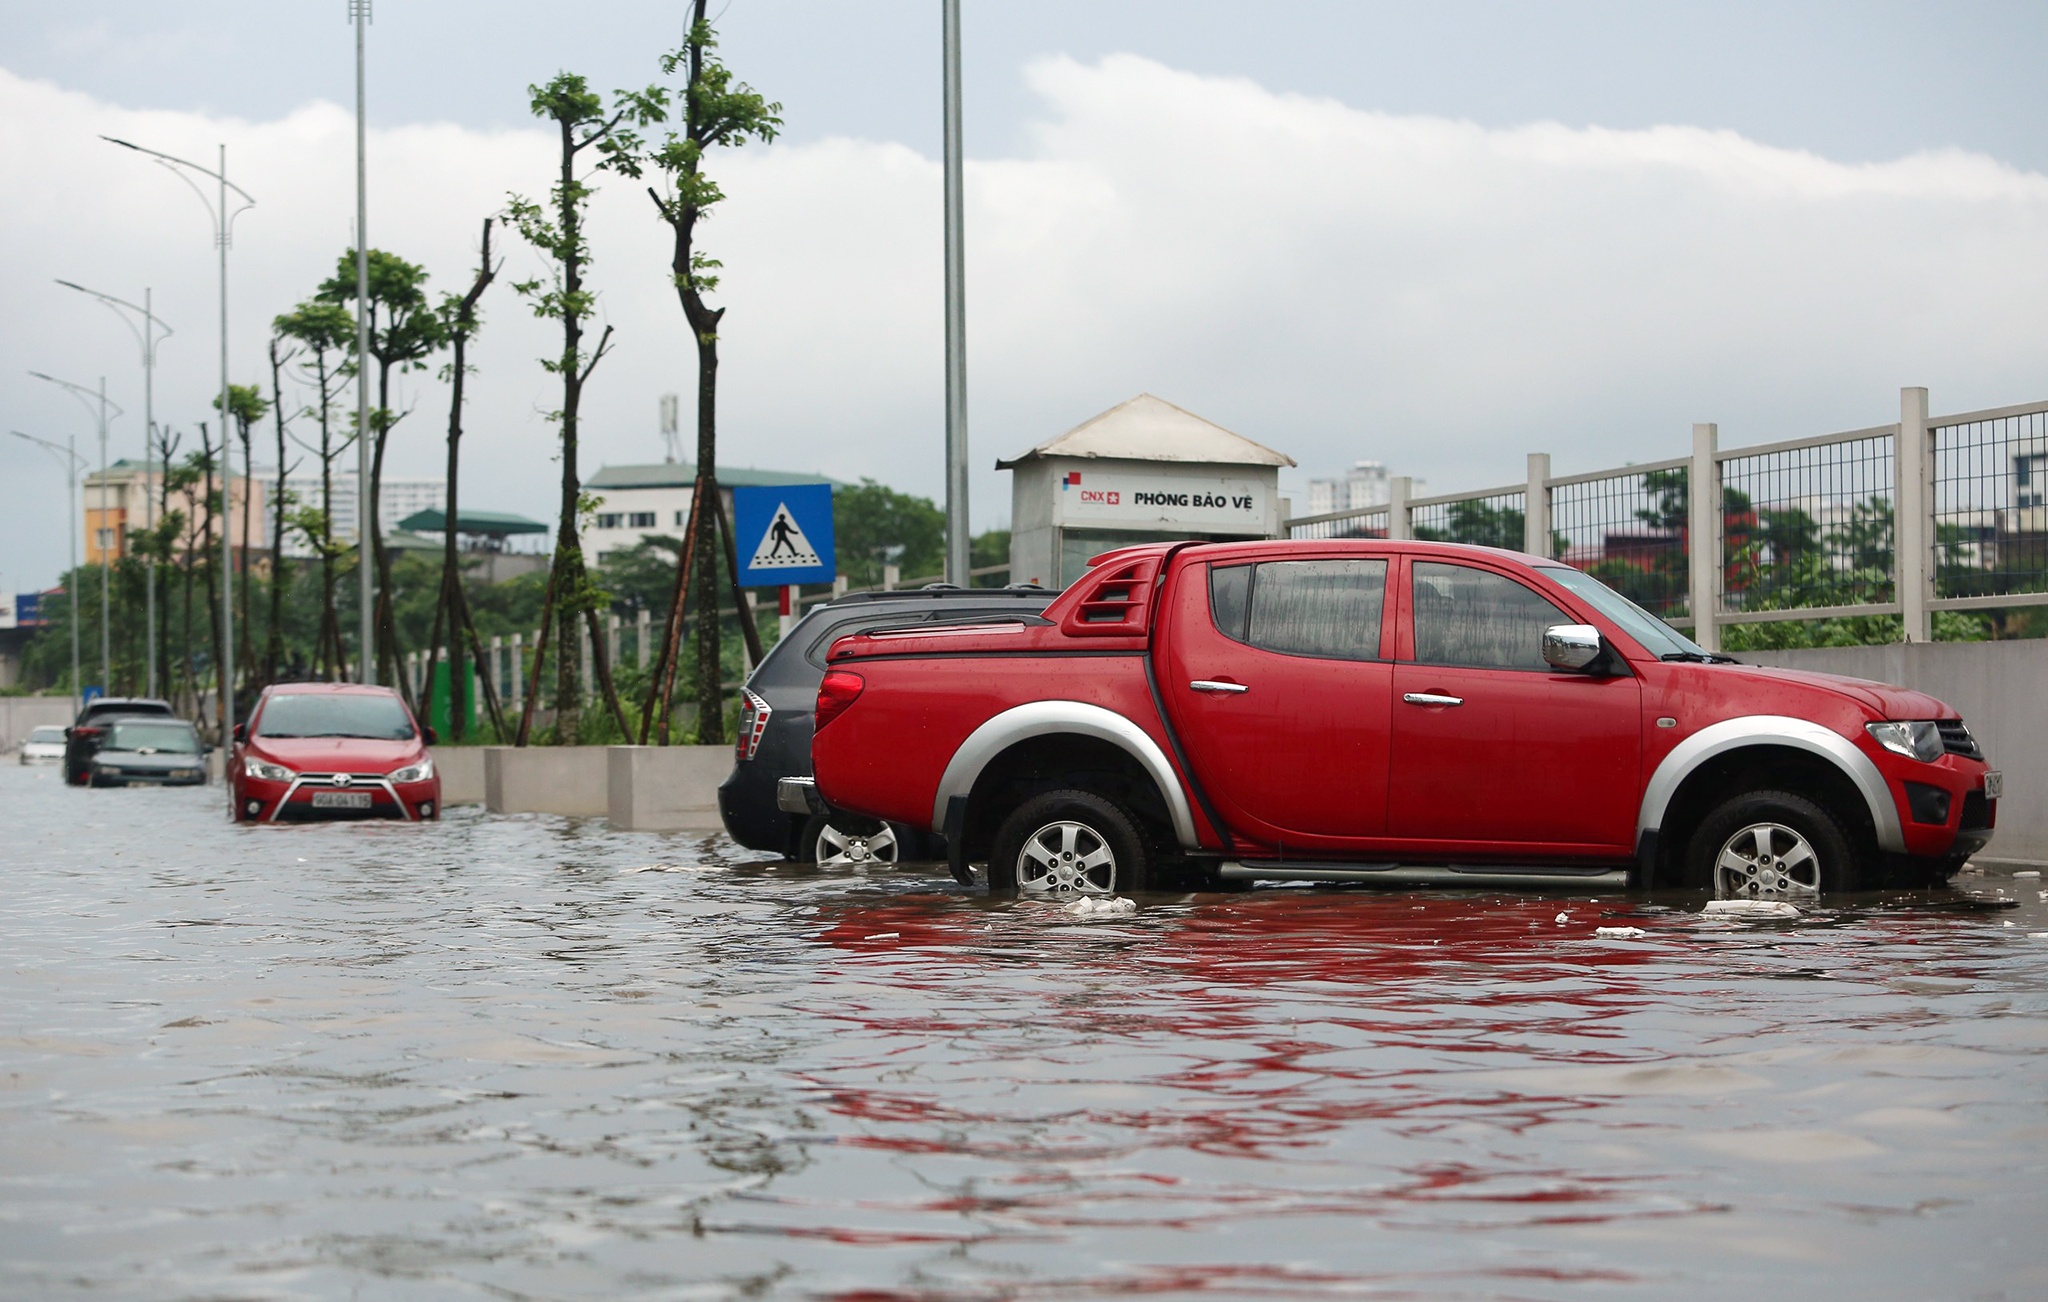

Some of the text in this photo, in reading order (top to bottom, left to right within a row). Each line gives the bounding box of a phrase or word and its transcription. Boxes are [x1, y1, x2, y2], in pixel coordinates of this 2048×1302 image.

[1081, 491, 1105, 502] CNX
[1134, 491, 1253, 512] PHÒNG BẢO VỆ
